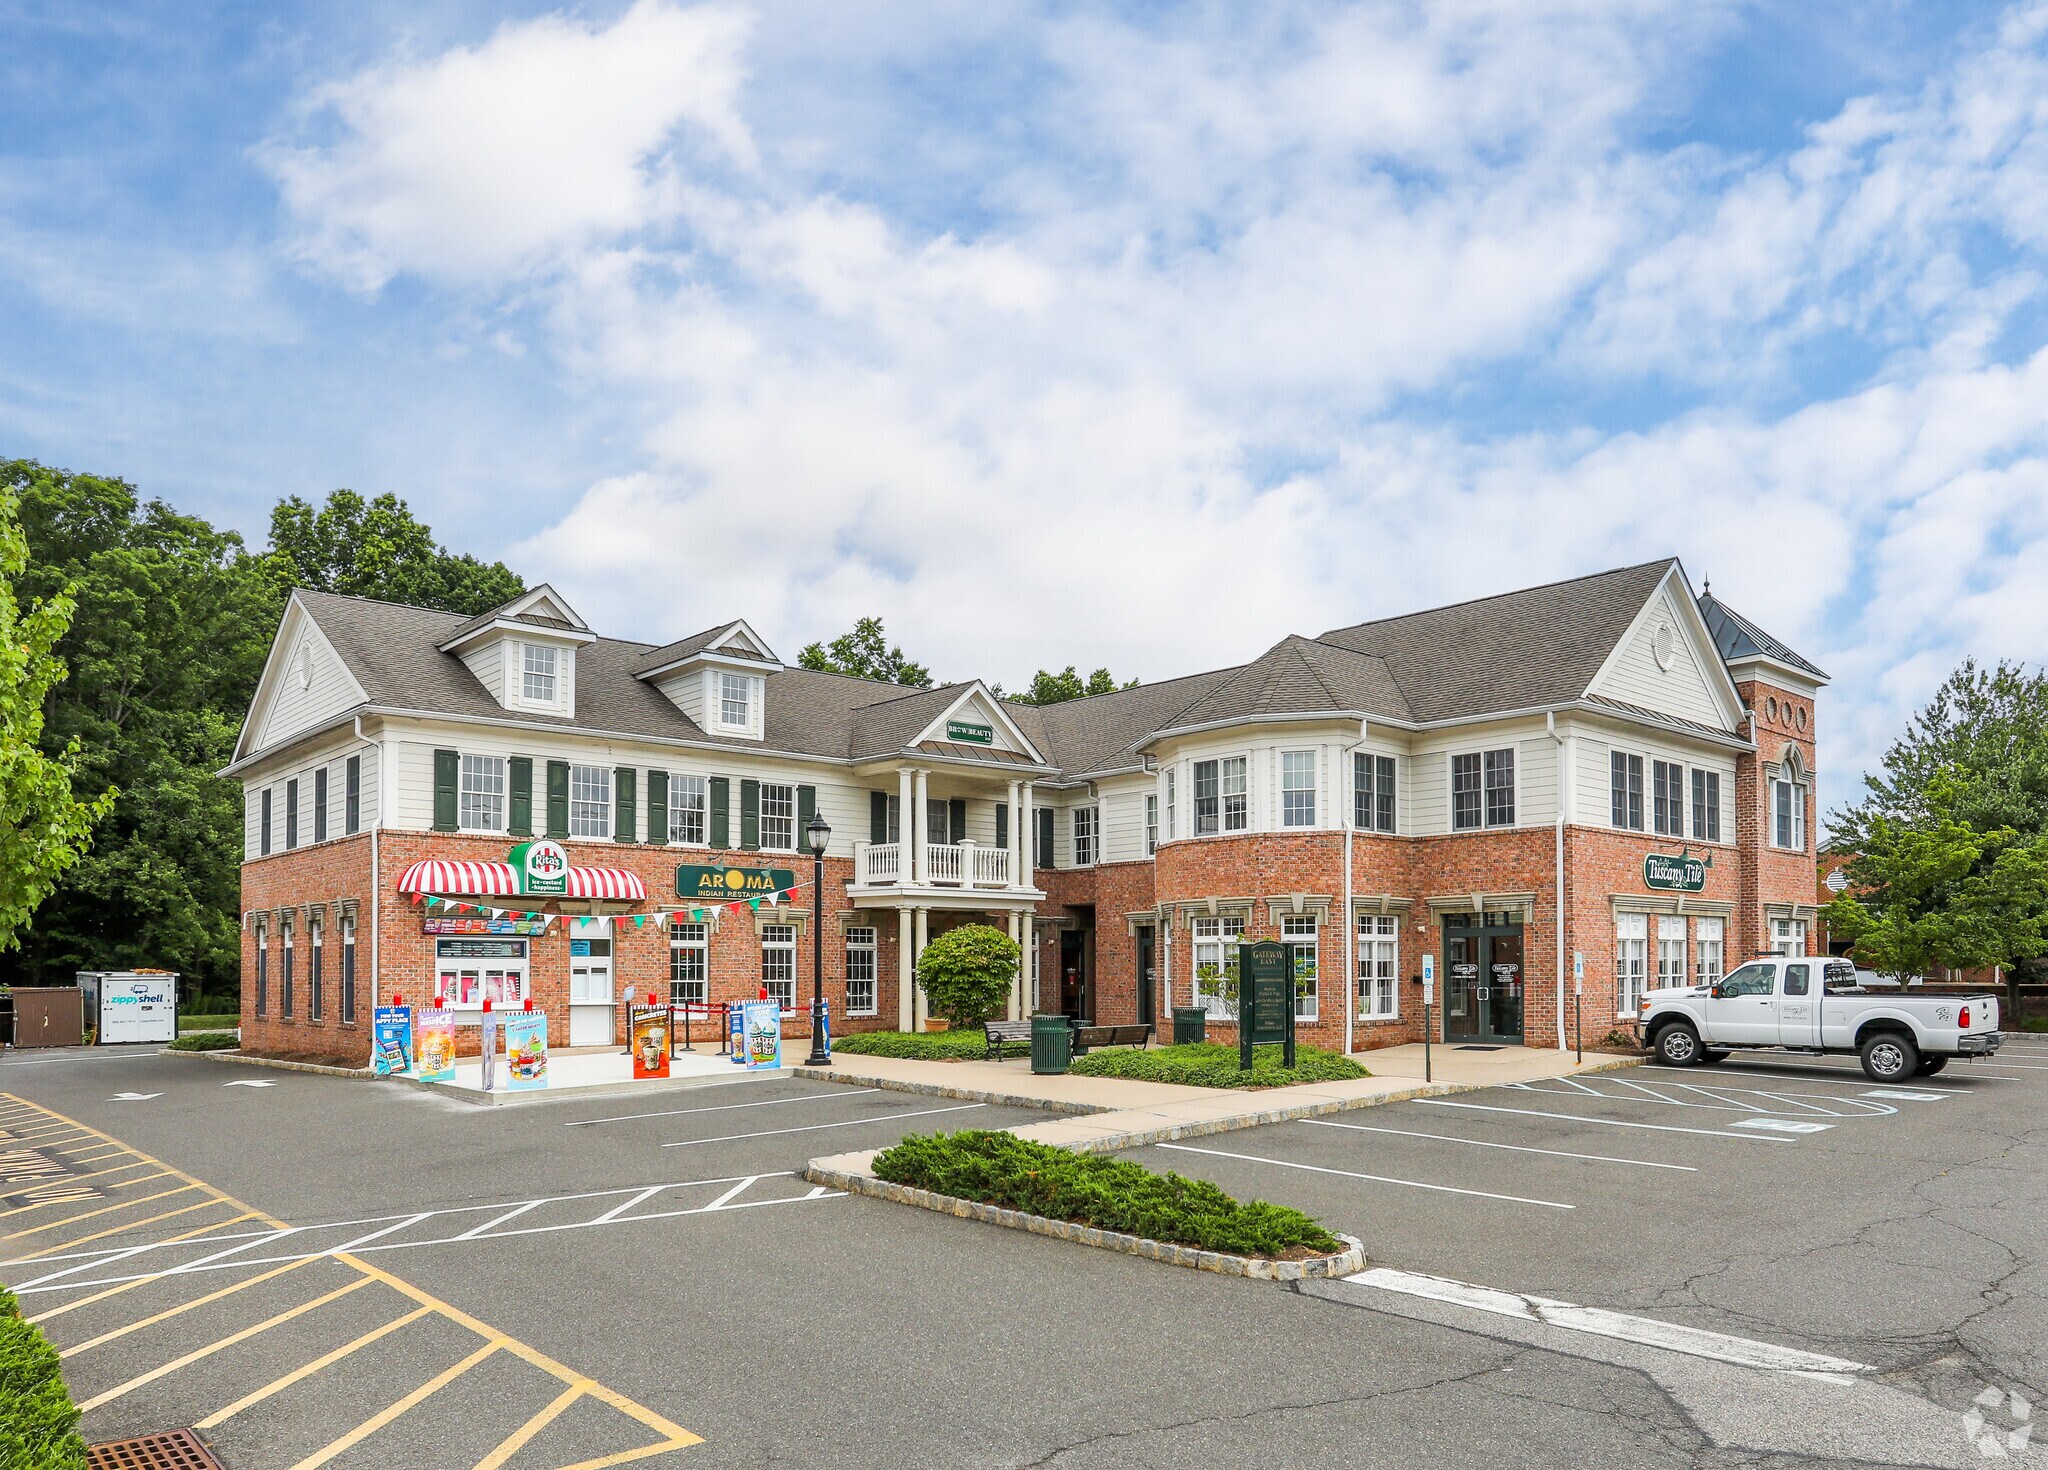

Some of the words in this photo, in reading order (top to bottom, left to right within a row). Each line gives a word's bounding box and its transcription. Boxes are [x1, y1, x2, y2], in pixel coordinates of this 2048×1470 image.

[535, 854, 560, 866] Rita's
[1648, 859, 1684, 885] Tuscany
[1685, 864, 1702, 883] Tile
[1252, 950, 1284, 959] GATEWAY
[634, 1009, 667, 1021] CONCRETES
